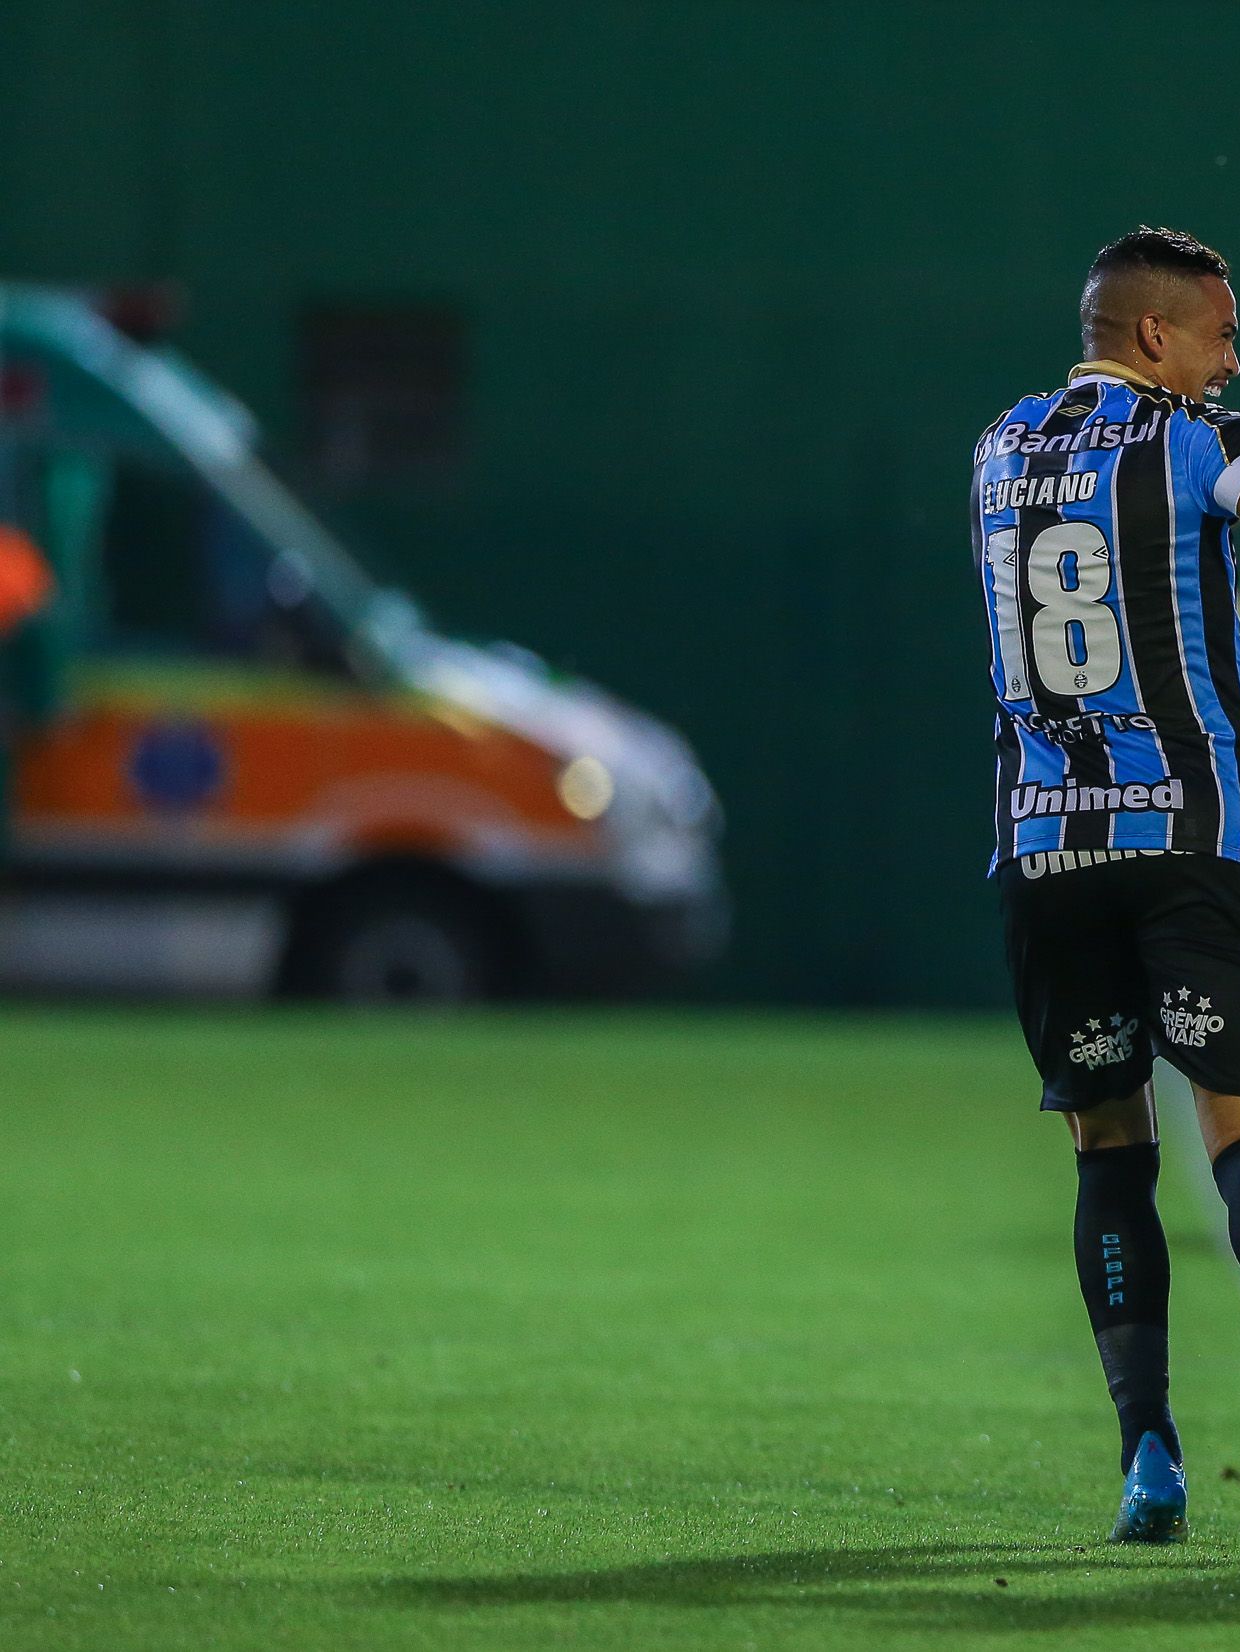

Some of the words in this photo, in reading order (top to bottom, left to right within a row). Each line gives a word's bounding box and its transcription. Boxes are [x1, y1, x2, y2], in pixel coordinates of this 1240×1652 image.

[996, 410, 1161, 455] Banrisul
[984, 471, 1097, 513] LUCIANO
[986, 522, 1121, 700] 18
[1010, 777, 1184, 819] Unimed
[1159, 1007, 1225, 1033] GRÊMIO
[1165, 1025, 1207, 1047] MAIS
[1083, 1038, 1133, 1071] MAIS
